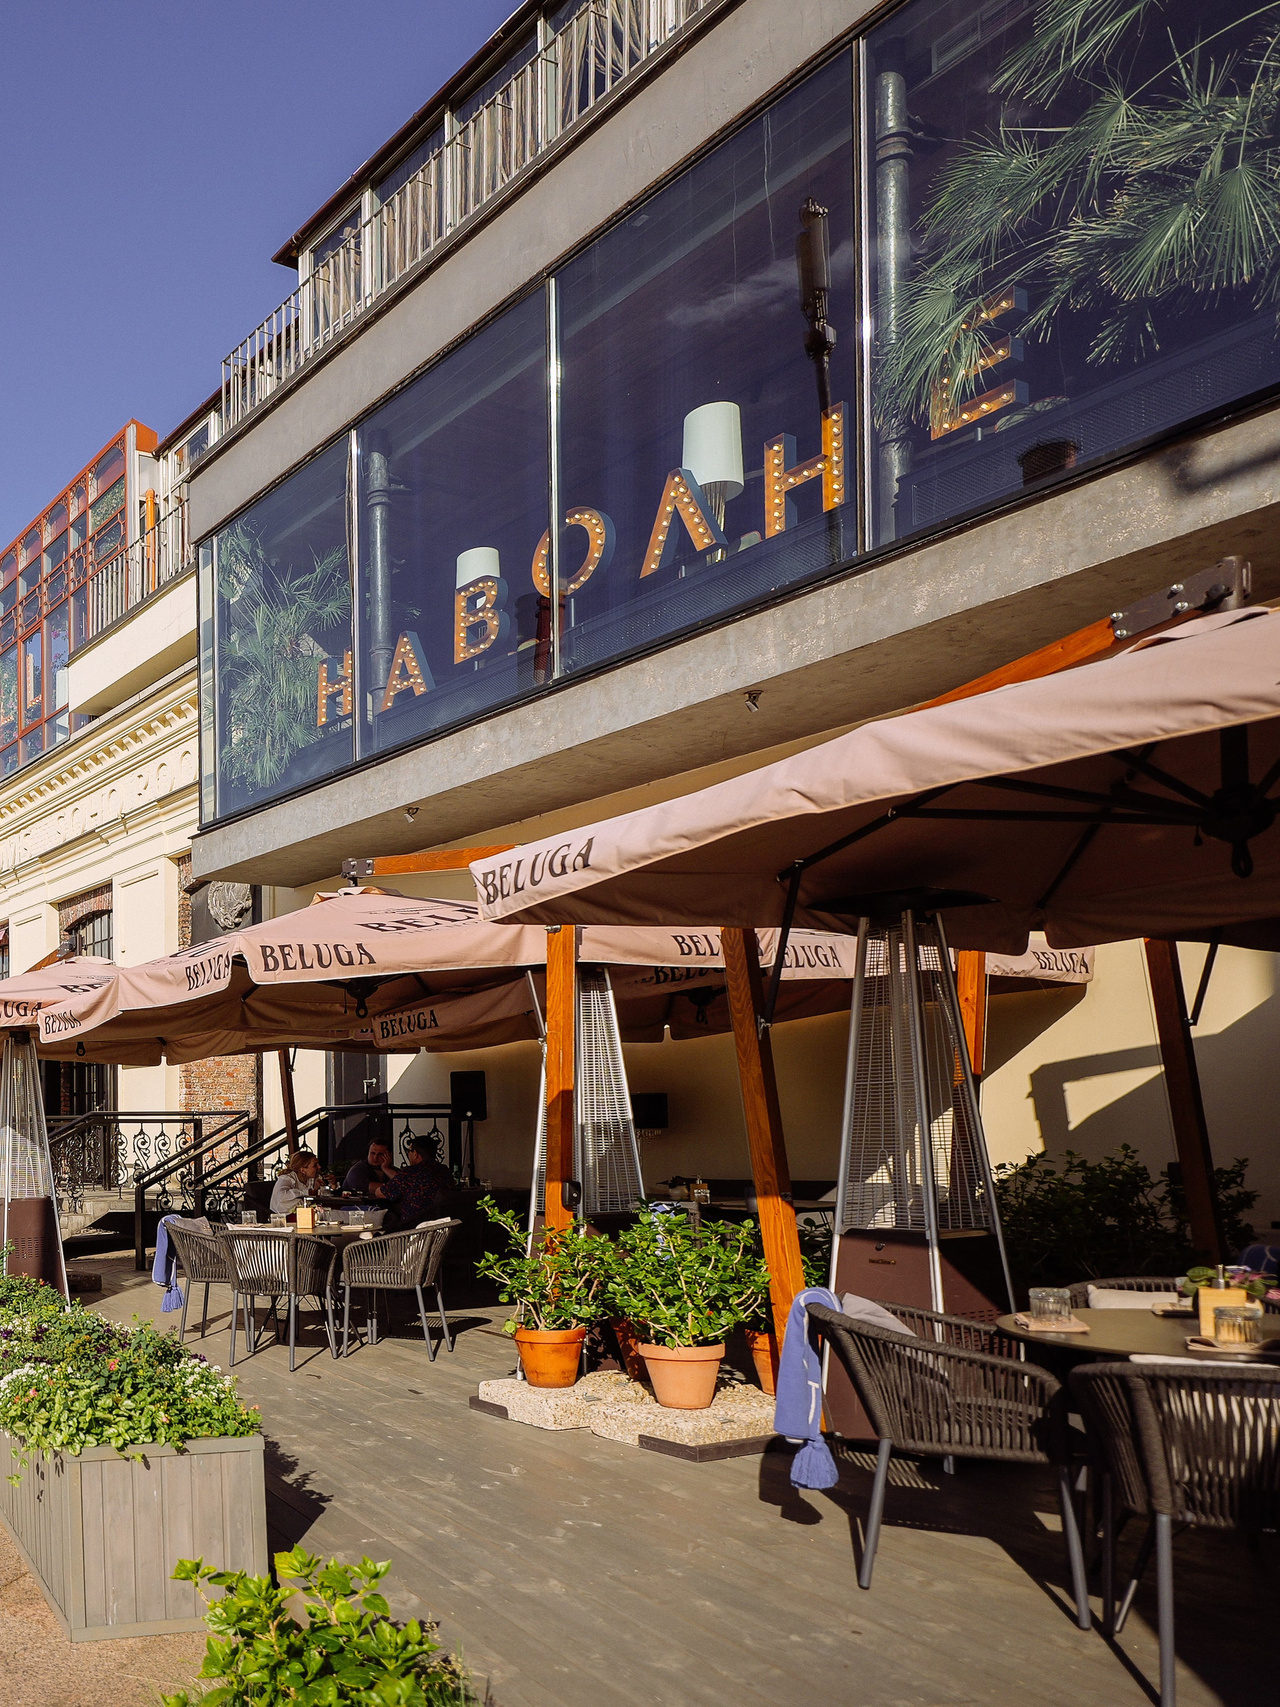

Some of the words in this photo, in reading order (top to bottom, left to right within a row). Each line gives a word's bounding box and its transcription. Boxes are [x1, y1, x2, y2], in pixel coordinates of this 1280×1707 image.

[482, 836, 596, 905] BELUGA
[185, 951, 231, 991] BELUGA
[260, 943, 377, 972] BELUGA
[783, 945, 842, 968] ELUGA
[44, 1010, 81, 1034] BELUGA
[380, 1009, 439, 1039] BELUGA
